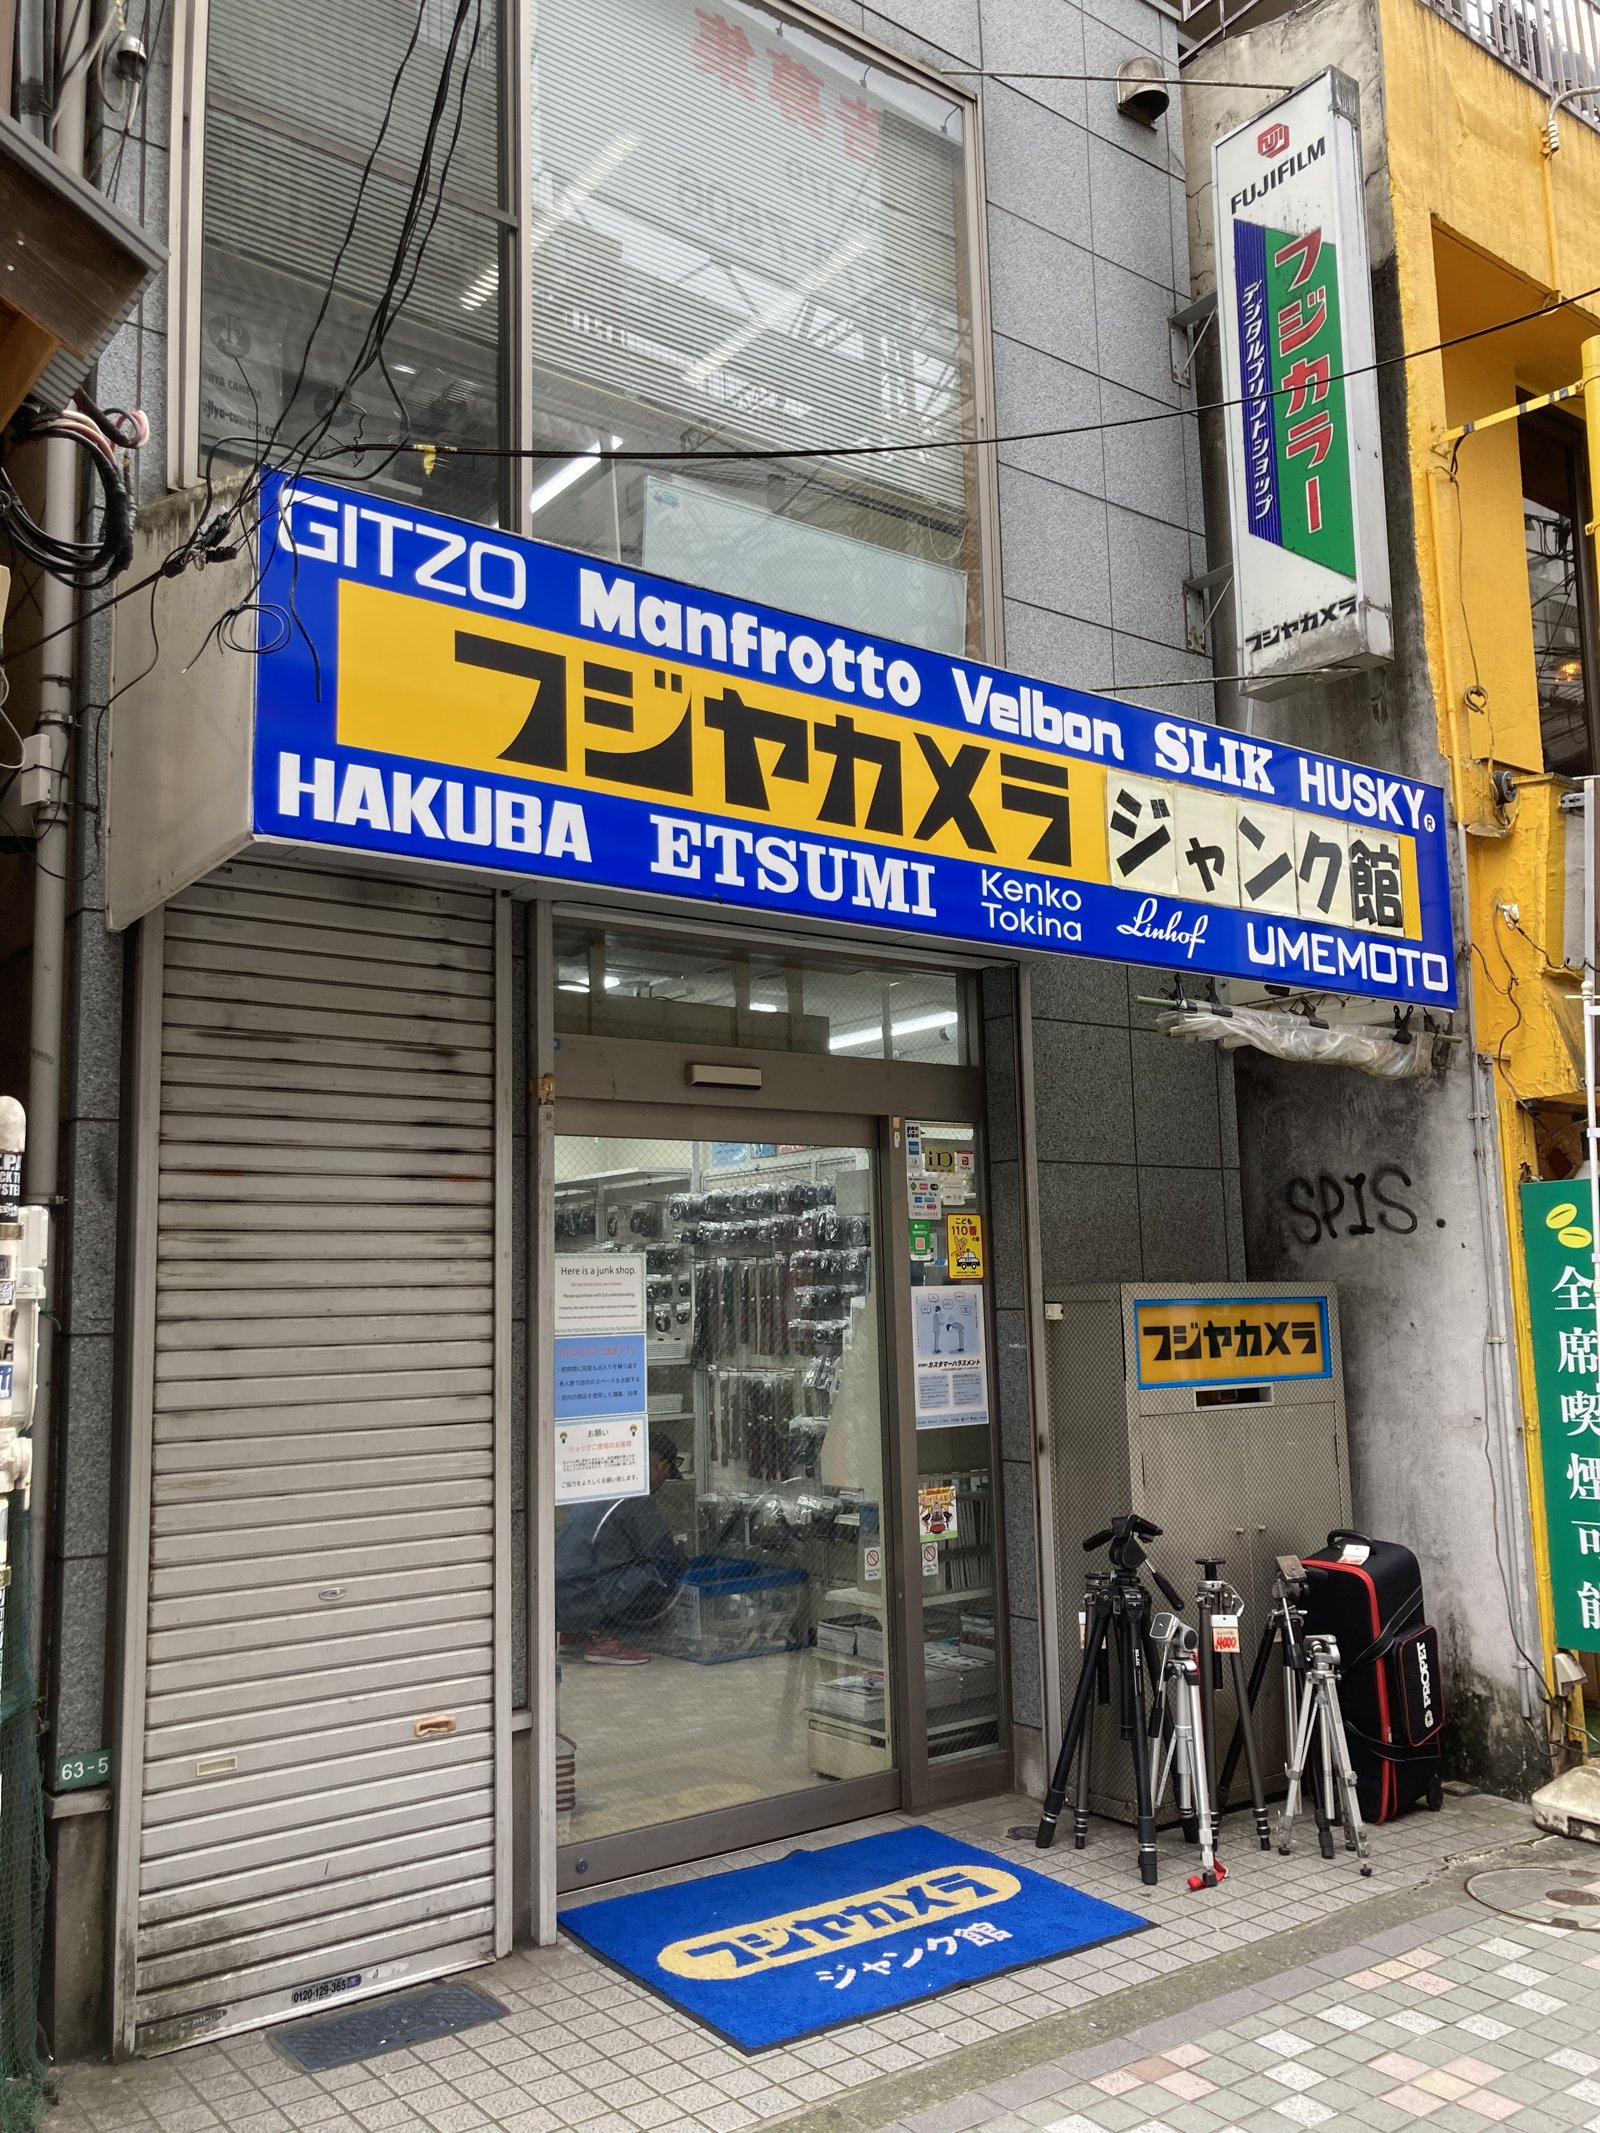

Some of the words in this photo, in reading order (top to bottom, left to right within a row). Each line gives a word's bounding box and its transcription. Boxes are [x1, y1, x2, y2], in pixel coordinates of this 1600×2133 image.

[1231, 136, 1325, 215] FUJIFILM
[1243, 279, 1273, 520] デジタルプリントショップ
[1274, 227, 1333, 534] フジカラー
[278, 489, 526, 610] GITZO
[580, 568, 921, 707] Manfrotto
[951, 667, 1124, 761] Velbon
[1154, 722, 1275, 795] SLIK
[1245, 595, 1357, 652] フジヤカメラ
[455, 630, 1072, 868] フジヤカメラ
[1110, 788, 1404, 928] ジャンク館
[278, 751, 592, 863] HAKUBA
[650, 813, 937, 918] ETSUMI
[981, 869, 1082, 911] Kenko
[981, 902, 1082, 942] Tokina
[1116, 898, 1209, 959] Linhof
[1247, 922, 1448, 993] UMEMOTO
[928, 1150, 953, 1168] iD
[951, 1225, 977, 1236] 110番
[956, 1217, 973, 1225] こども
[561, 1267, 580, 1275] Here
[582, 1266, 588, 1274] is
[596, 1266, 614, 1277] junk
[928, 1359, 980, 1368] カスタマーハラスメント
[1143, 1319, 1317, 1361] フジヤカメラ
[588, 1429, 608, 1438] お願い
[61, 1757, 109, 1780] 63-5
[684, 1873, 999, 1968] フジヤカメラ
[815, 1922, 1014, 1989] ジャンク館
[293, 1980, 346, 2003] 0120-129-365
